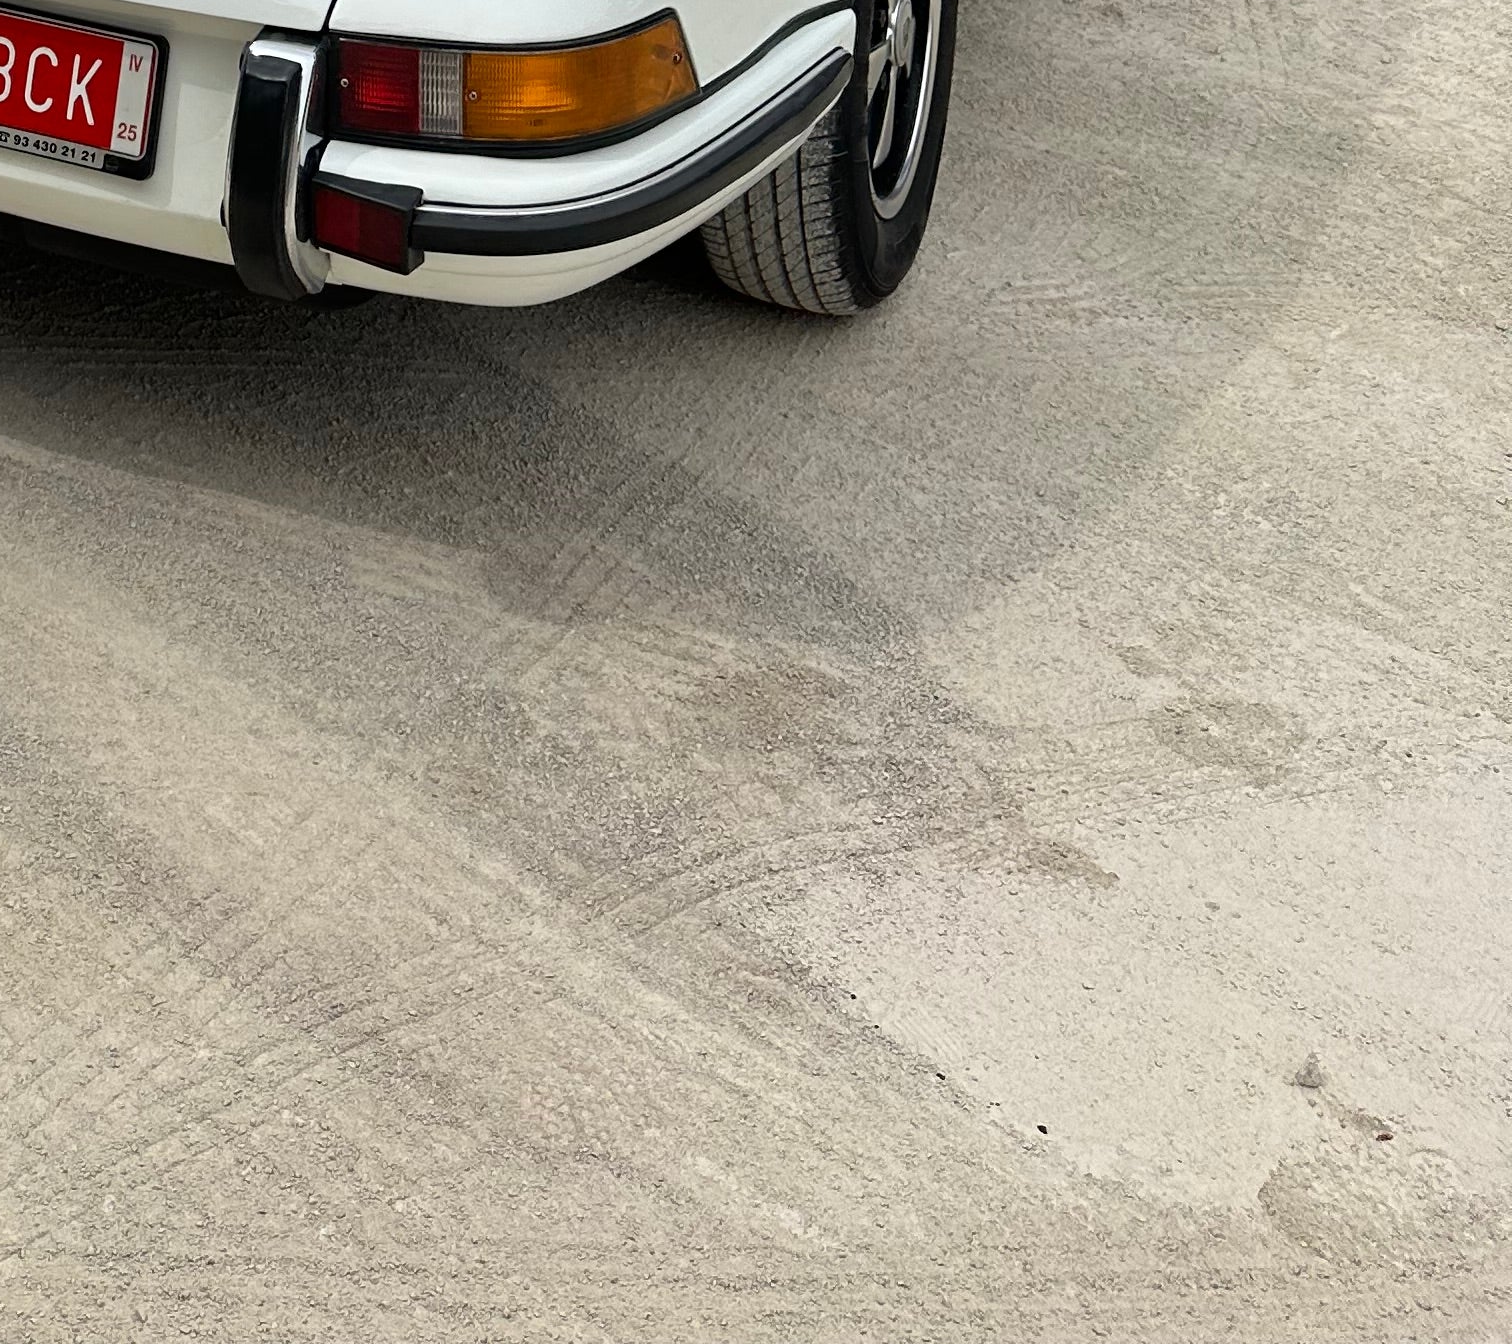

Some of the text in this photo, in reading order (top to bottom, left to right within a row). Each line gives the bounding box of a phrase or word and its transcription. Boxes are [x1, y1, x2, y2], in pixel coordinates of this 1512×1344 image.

[129, 54, 144, 73] IV
[117, 122, 138, 142] 25
[13, 134, 30, 148] 93
[33, 139, 58, 154] 430
[61, 144, 76, 159] 21
[81, 150, 97, 164] 21
